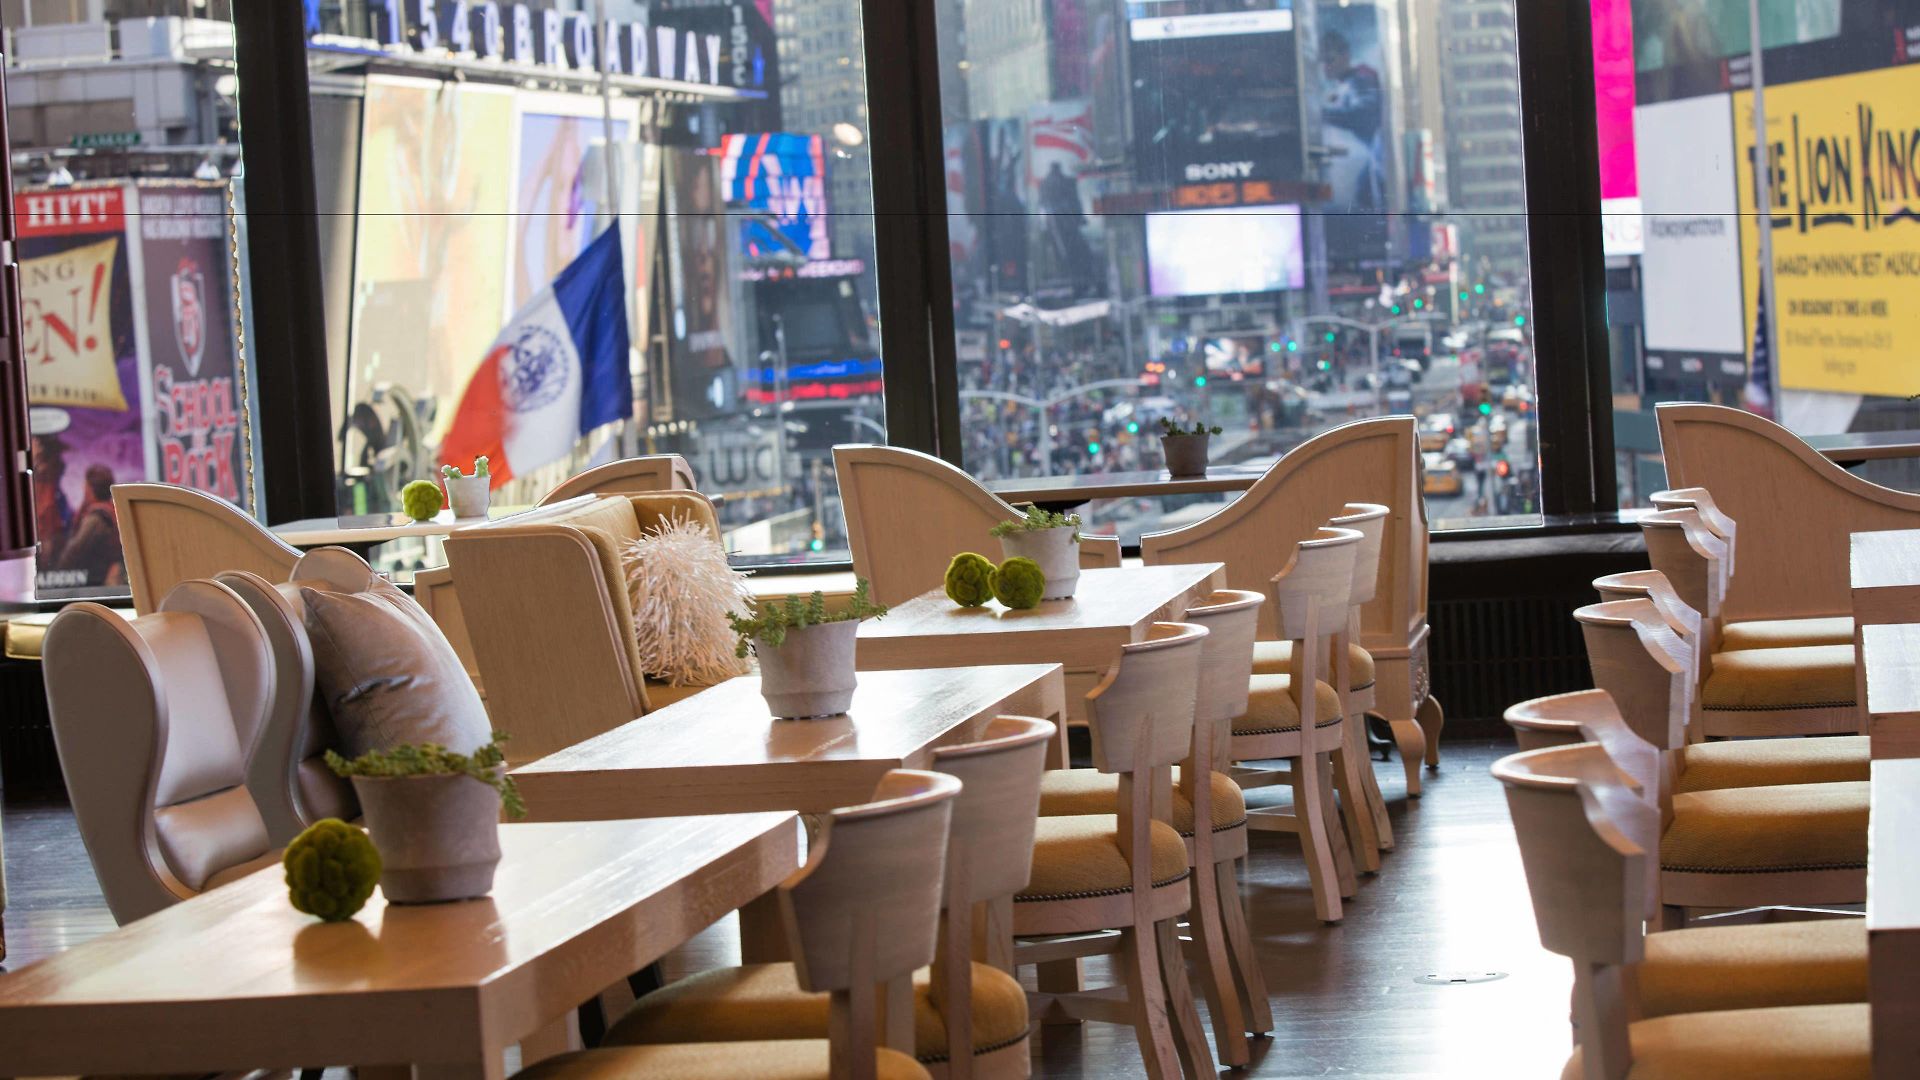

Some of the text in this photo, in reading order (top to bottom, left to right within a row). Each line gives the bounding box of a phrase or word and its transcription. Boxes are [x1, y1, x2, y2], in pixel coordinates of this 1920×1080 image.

[1185, 161, 1254, 181] SONY
[1792, 112, 1854, 233] LION
[27, 193, 107, 228] HIT!
[154, 364, 237, 438] SCHOOL
[163, 432, 239, 501] ROCK
